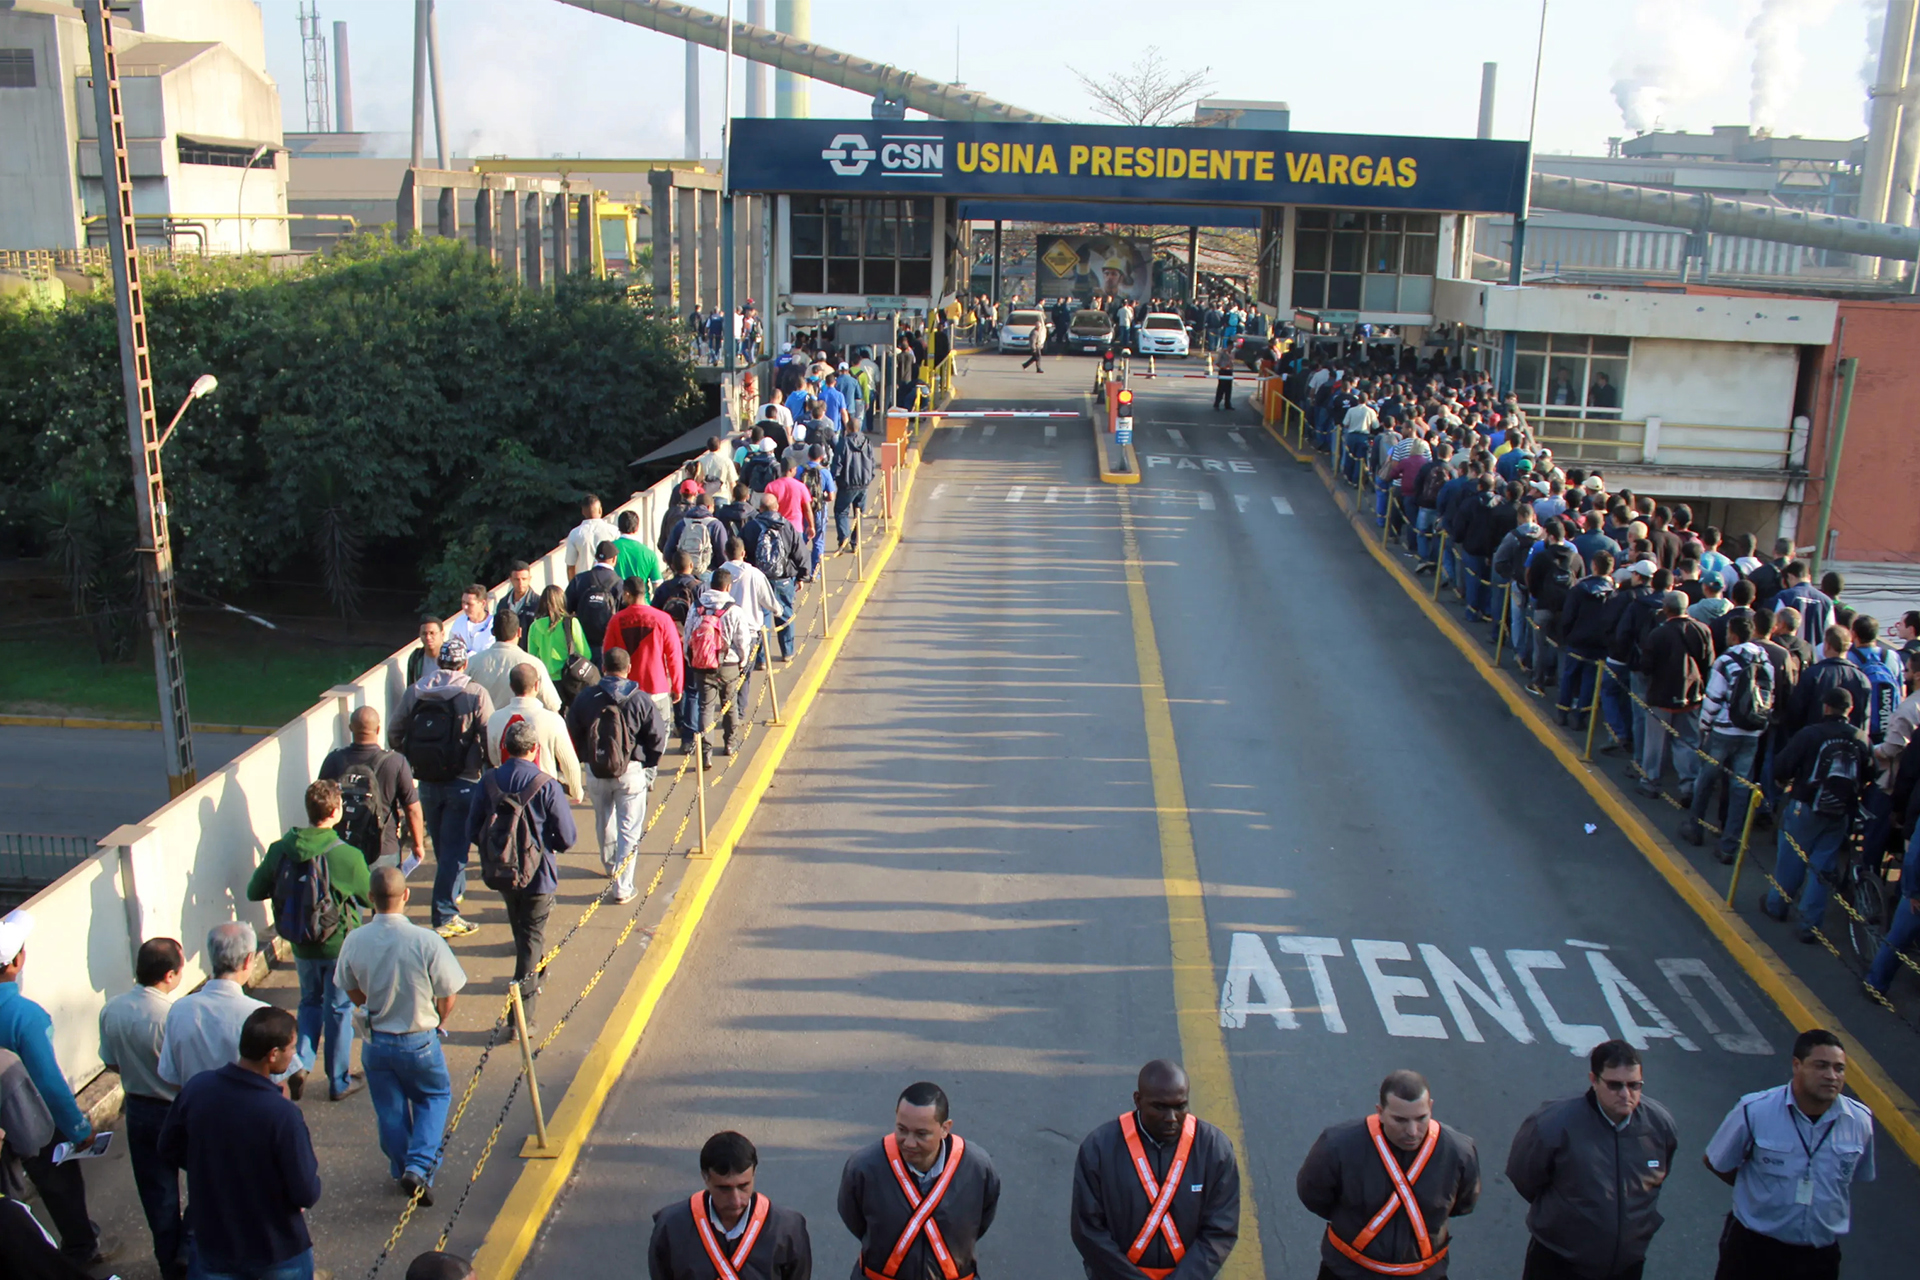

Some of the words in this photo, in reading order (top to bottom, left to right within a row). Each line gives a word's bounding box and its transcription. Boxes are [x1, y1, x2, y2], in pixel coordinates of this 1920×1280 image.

[880, 143, 944, 170] CSN
[956, 141, 1059, 175] USINA
[1068, 144, 1275, 182] PRESIDENTE
[1284, 151, 1418, 189] VARGAS
[1145, 455, 1258, 474] PARE
